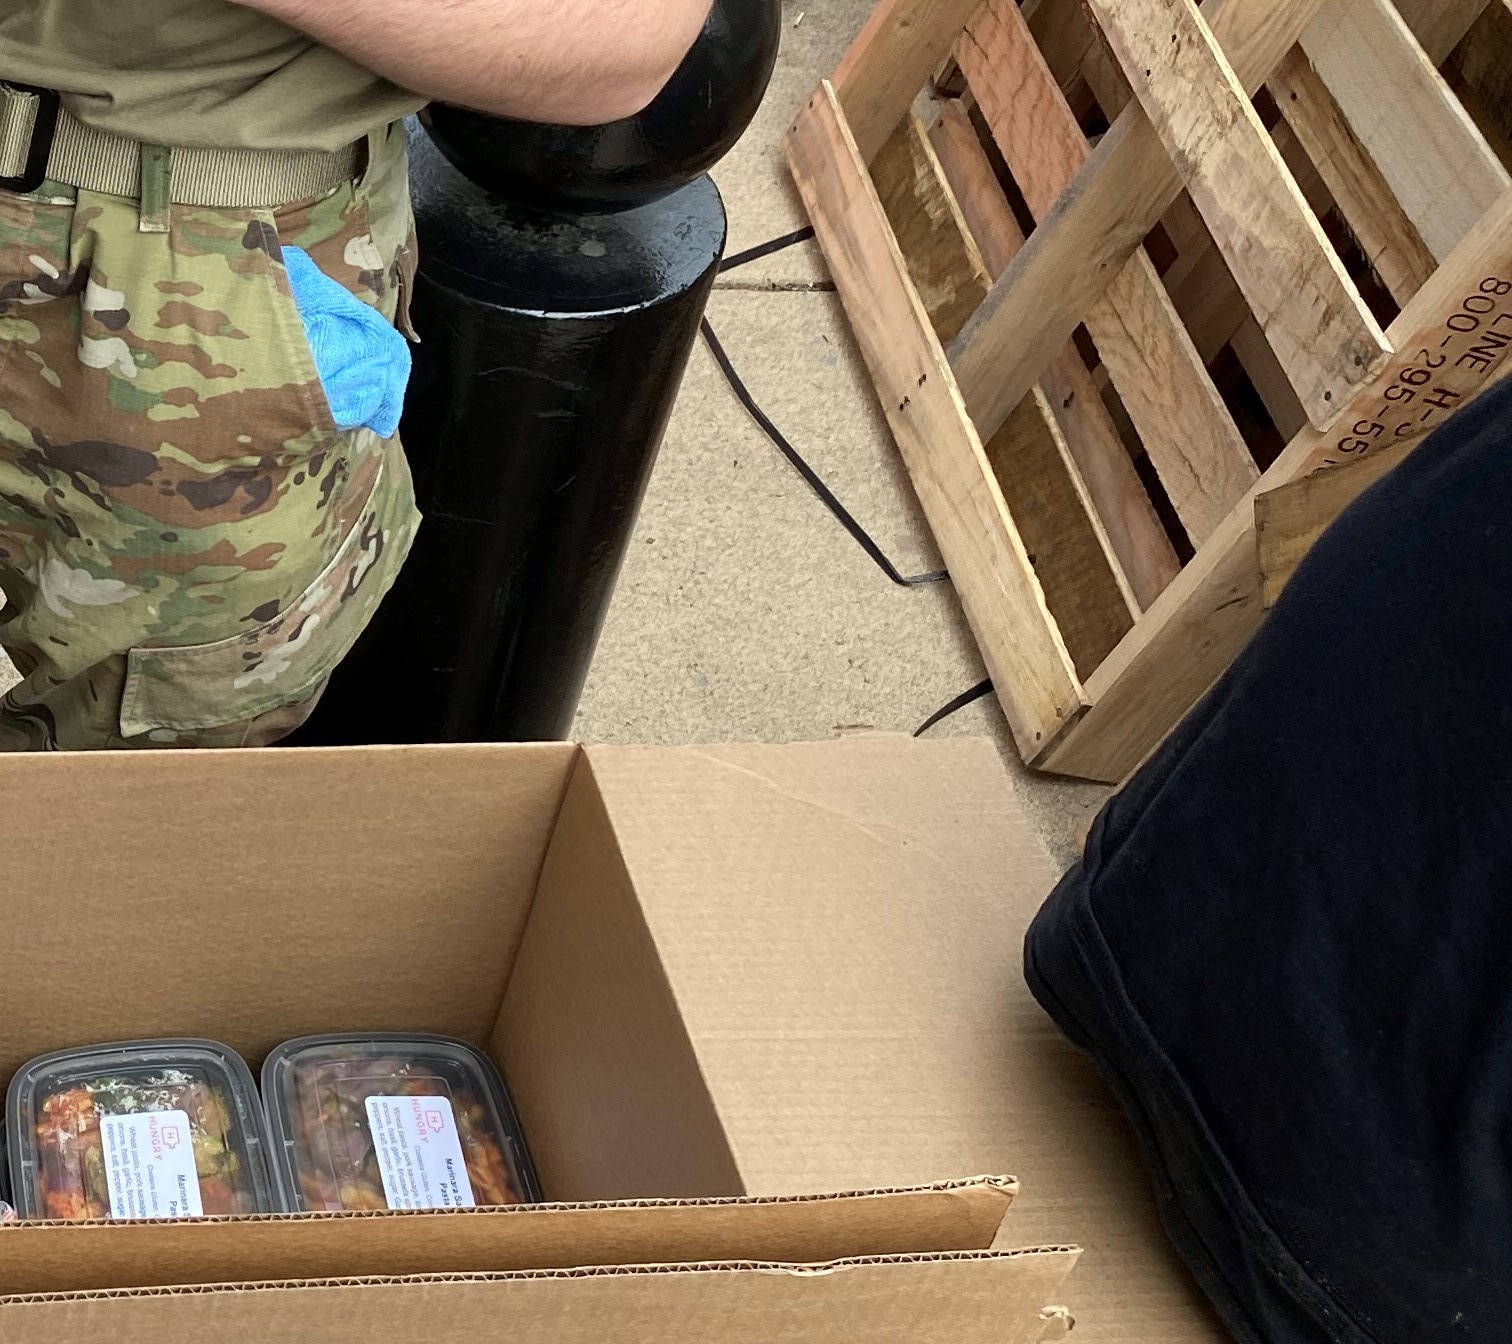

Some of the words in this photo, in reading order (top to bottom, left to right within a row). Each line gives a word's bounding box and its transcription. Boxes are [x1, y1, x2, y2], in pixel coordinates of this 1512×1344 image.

[1323, 277, 1511, 466] 800-295-55
[148, 1115, 162, 1161] HUNGRY
[410, 1098, 429, 1143] HUNGRY
[177, 1174, 189, 1211] Marinara
[439, 1182, 451, 1206] Pasta
[445, 1158, 459, 1194] Marinara
